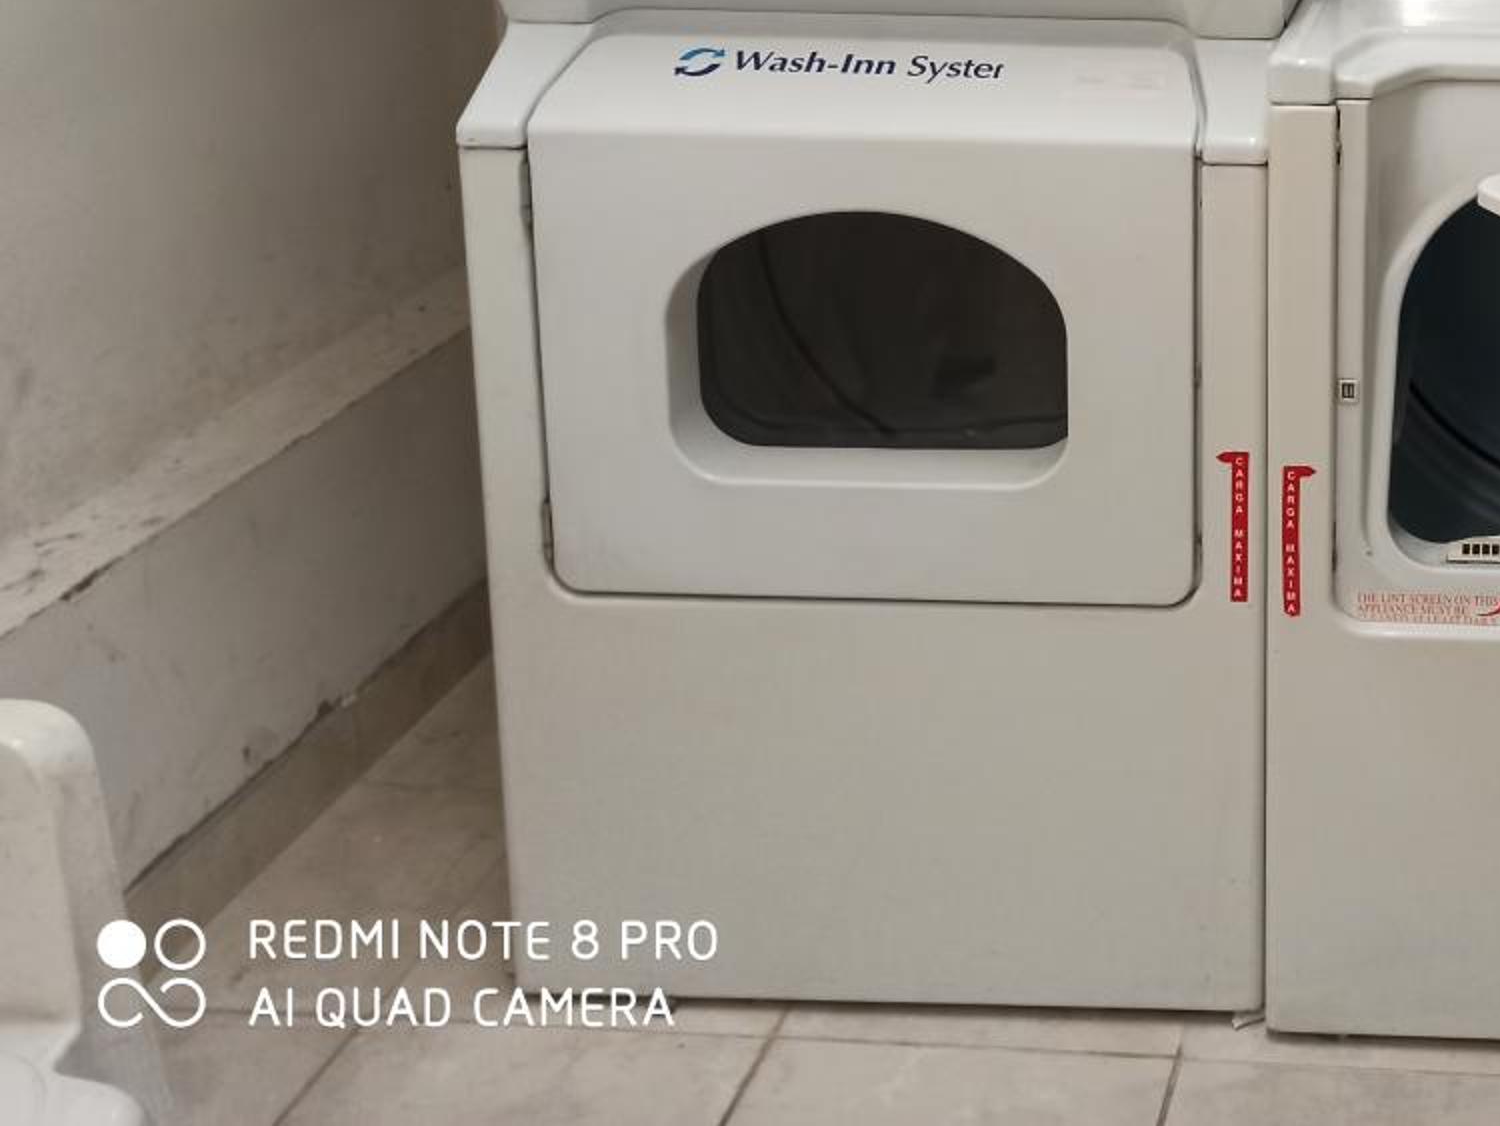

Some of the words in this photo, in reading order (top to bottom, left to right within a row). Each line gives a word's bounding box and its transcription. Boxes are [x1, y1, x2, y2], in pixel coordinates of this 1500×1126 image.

[736, 50, 896, 75] Wash-Inn
[1235, 457, 1244, 513] CARGA
[1286, 471, 1296, 529] CARGA
[1233, 529, 1243, 597] MAXIMA
[1285, 544, 1296, 613] MAXIMA
